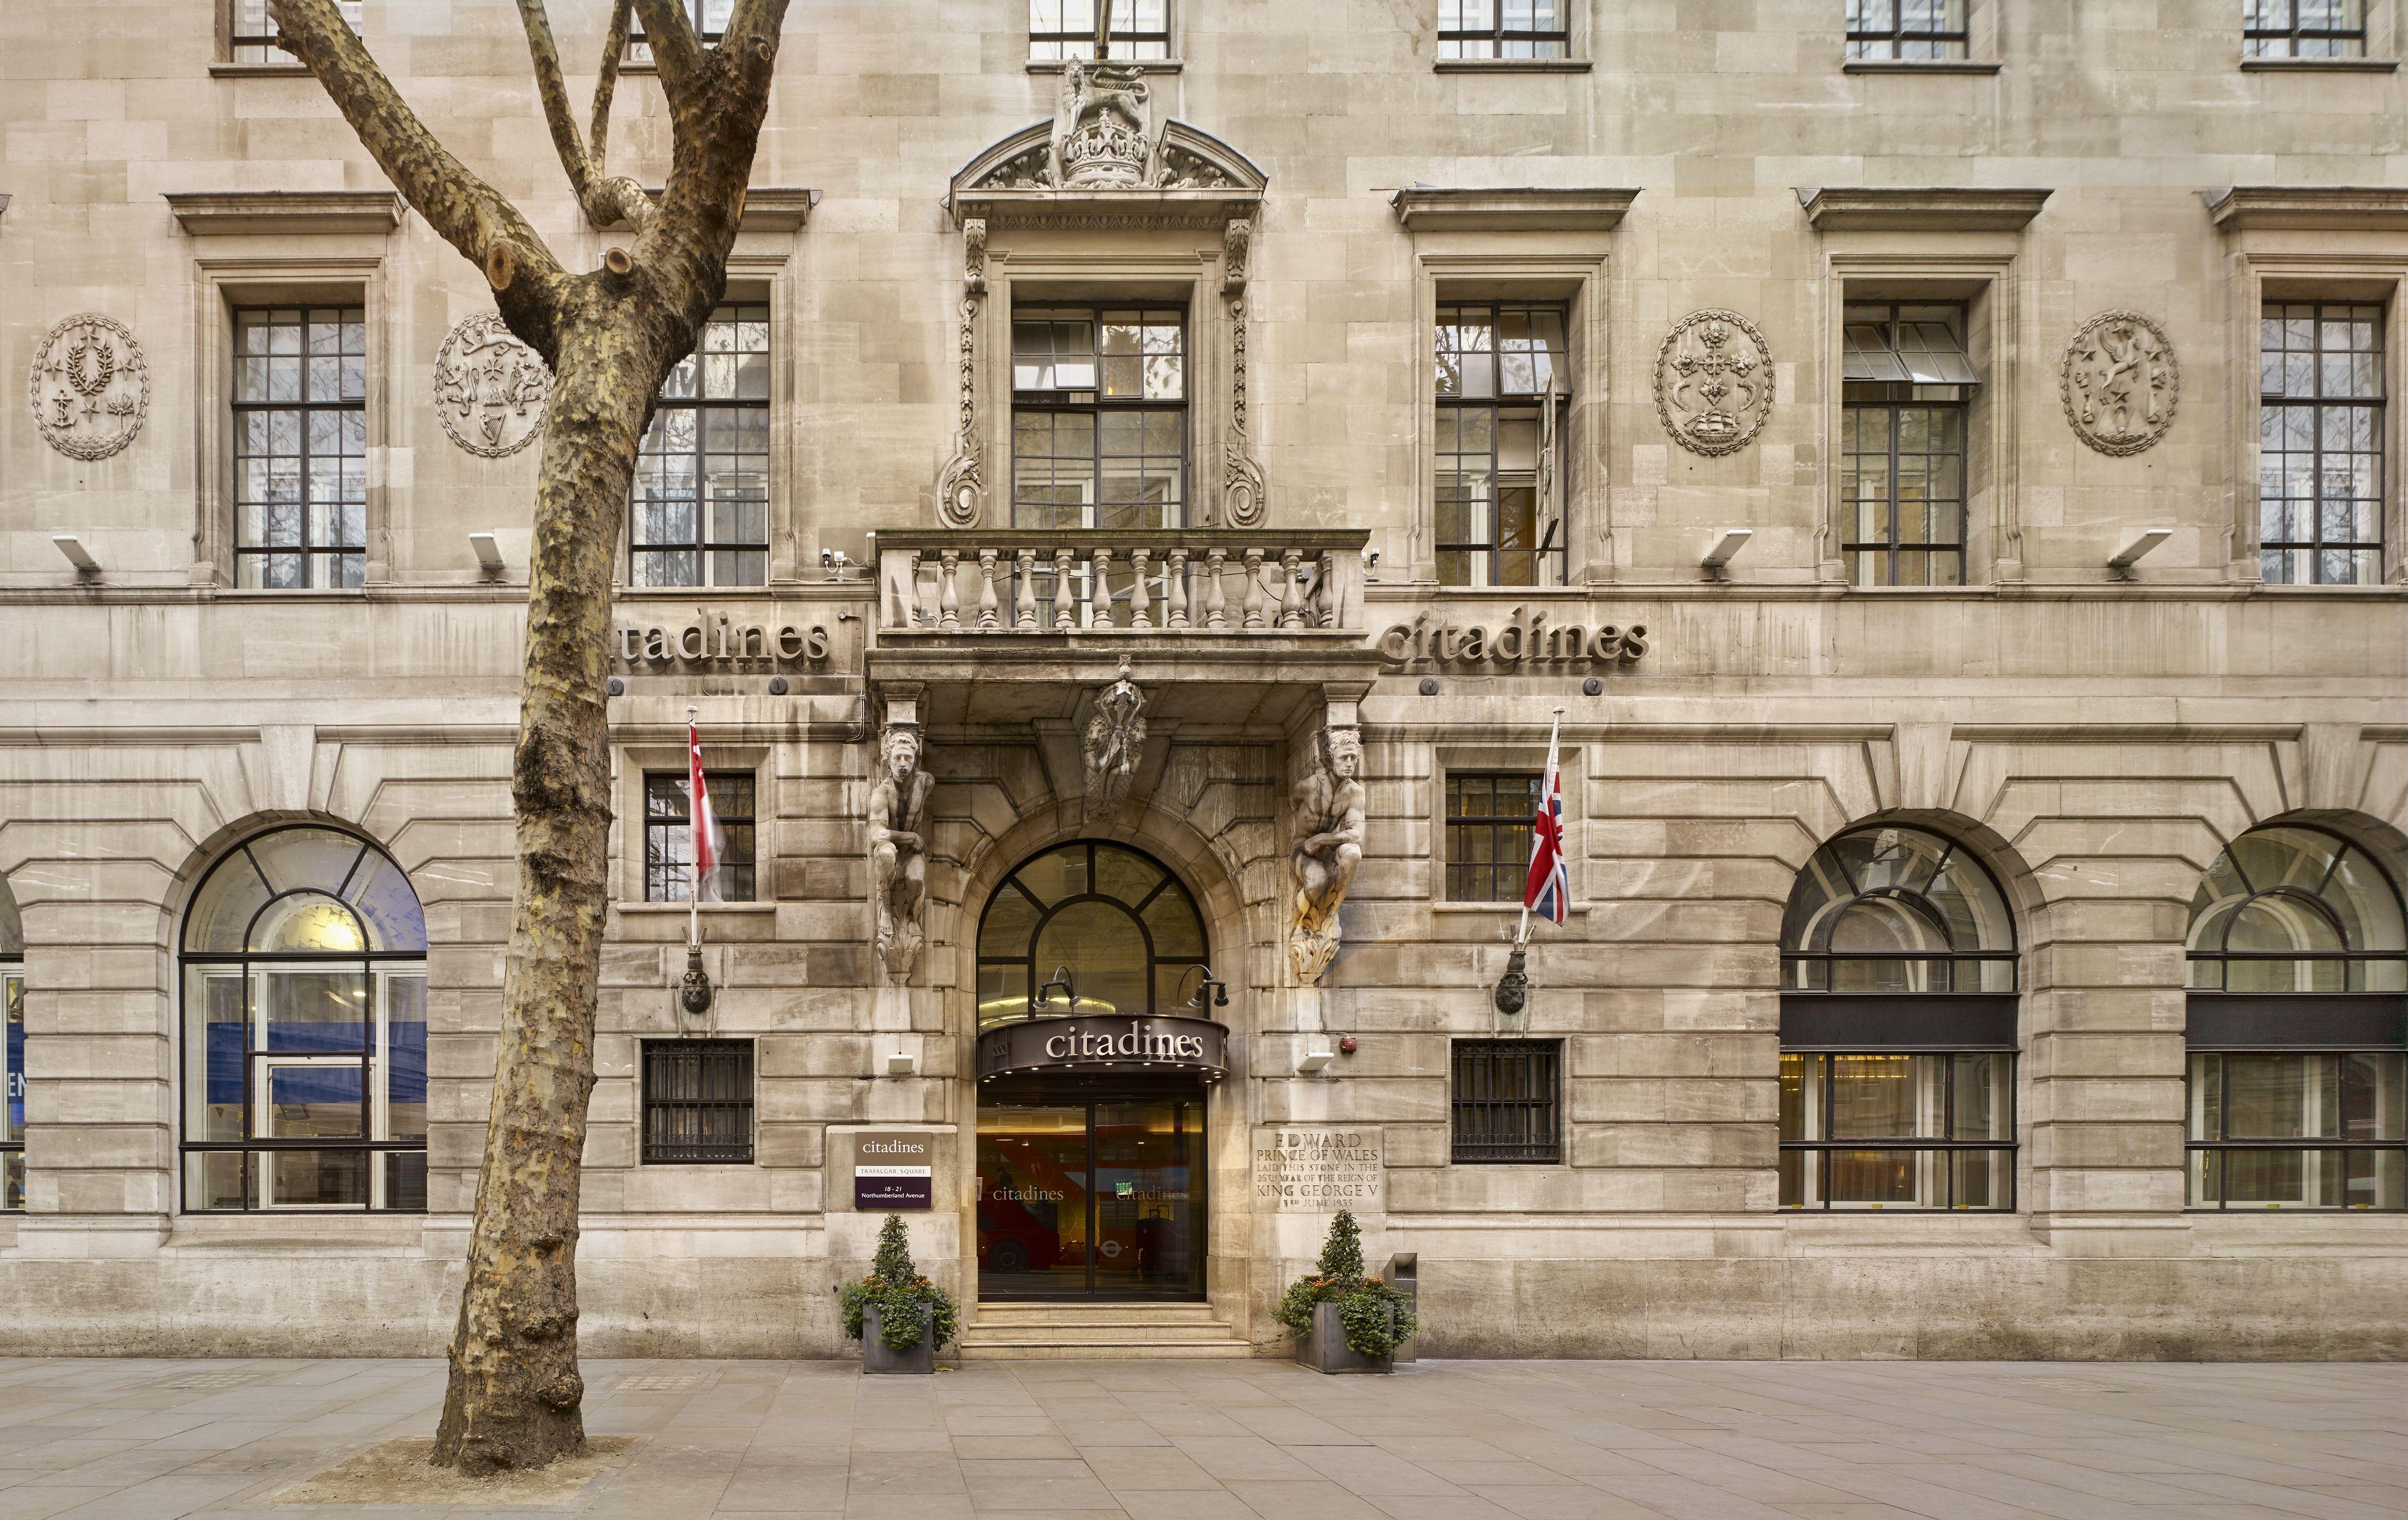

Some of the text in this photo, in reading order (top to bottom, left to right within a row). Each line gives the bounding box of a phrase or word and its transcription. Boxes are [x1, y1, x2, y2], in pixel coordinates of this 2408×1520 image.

[610, 604, 829, 664] tadines
[1380, 603, 1649, 664] citadines
[1046, 1020, 1203, 1058] citadines
[862, 1139, 924, 1153] citadines
[1275, 1134, 1361, 1148] EDWARD
[1257, 1149, 1378, 1161] PRINCE OF WALES
[1280, 1174, 1301, 1182] YEAR
[1304, 1174, 1315, 1182] OF
[1318, 1174, 1335, 1182] THE
[1338, 1174, 1364, 1182] REIGN
[1366, 1174, 1378, 1182] OF
[993, 1185, 1064, 1201] citadines
[1257, 1185, 1378, 1196] KING GEORGE V
